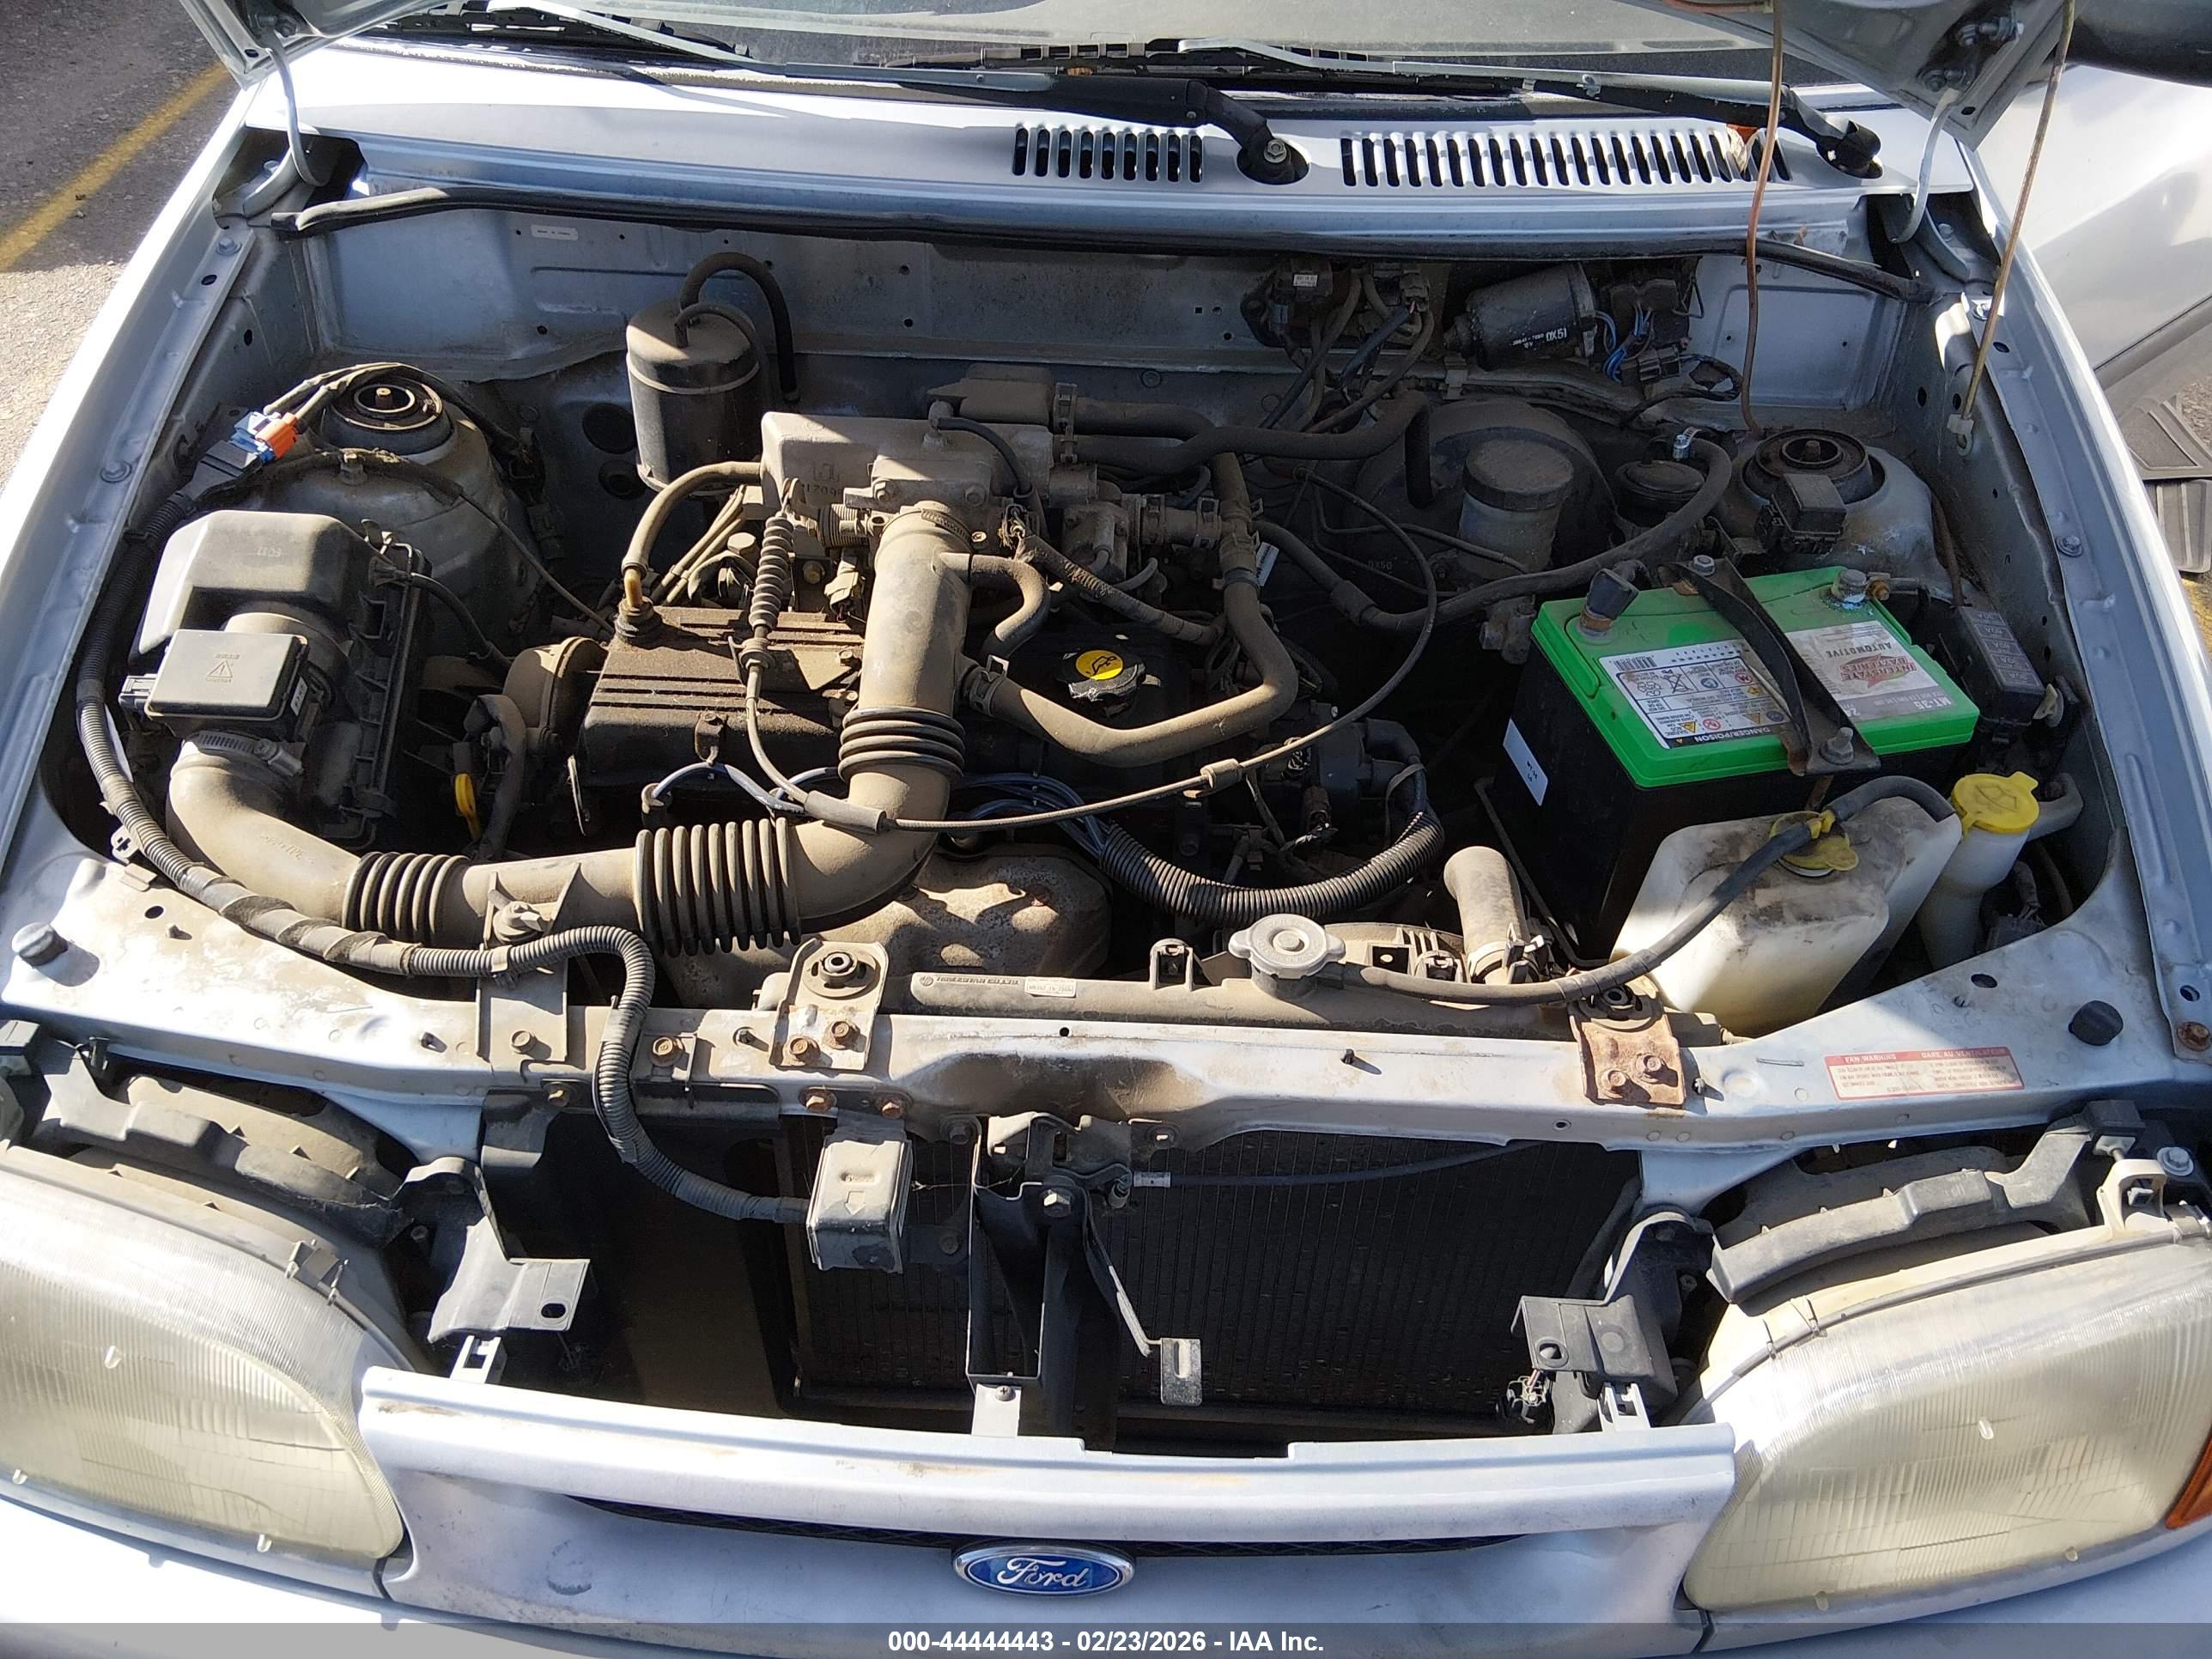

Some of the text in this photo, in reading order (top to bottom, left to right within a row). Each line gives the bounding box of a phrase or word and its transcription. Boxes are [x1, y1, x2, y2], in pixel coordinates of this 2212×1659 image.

[1826, 641, 1892, 658] AUTOMOTIVE
[1840, 656, 1909, 672] BATTERIES
[1840, 662, 1917, 681] INTERSTATE
[1693, 726, 1771, 743] DANGER/POISON
[1862, 1054, 1896, 1062] WARNING
[997, 1557, 1089, 1587] Ford
